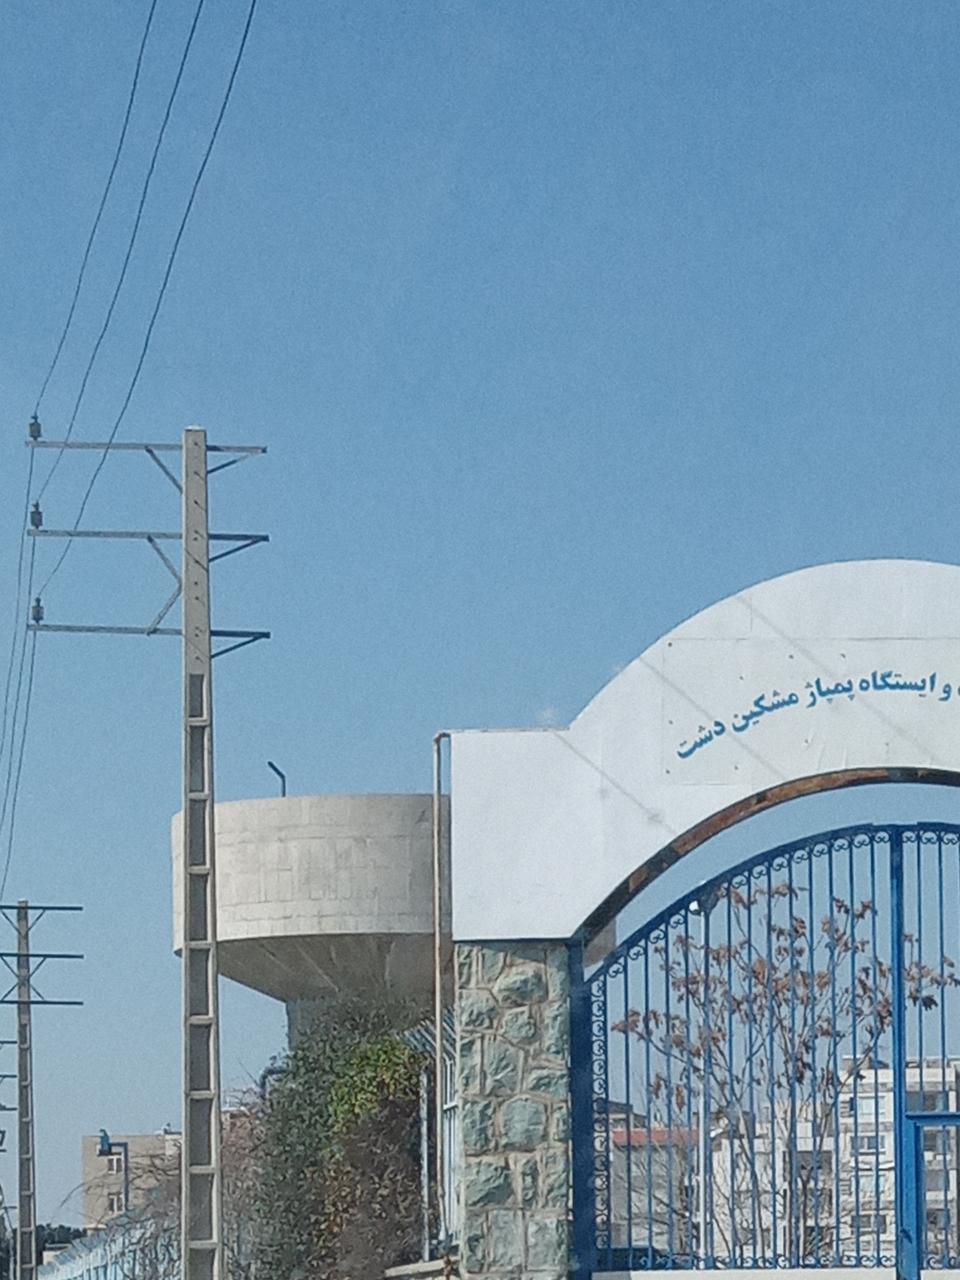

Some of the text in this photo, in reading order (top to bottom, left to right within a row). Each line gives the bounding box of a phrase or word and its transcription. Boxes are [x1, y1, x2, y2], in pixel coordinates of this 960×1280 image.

[804, 676, 855, 708] پمپاژ
[858, 671, 937, 698] ایستگاه
[938, 682, 952, 701] و
[731, 689, 799, 733] مشکین
[676, 718, 726, 759] دشت
